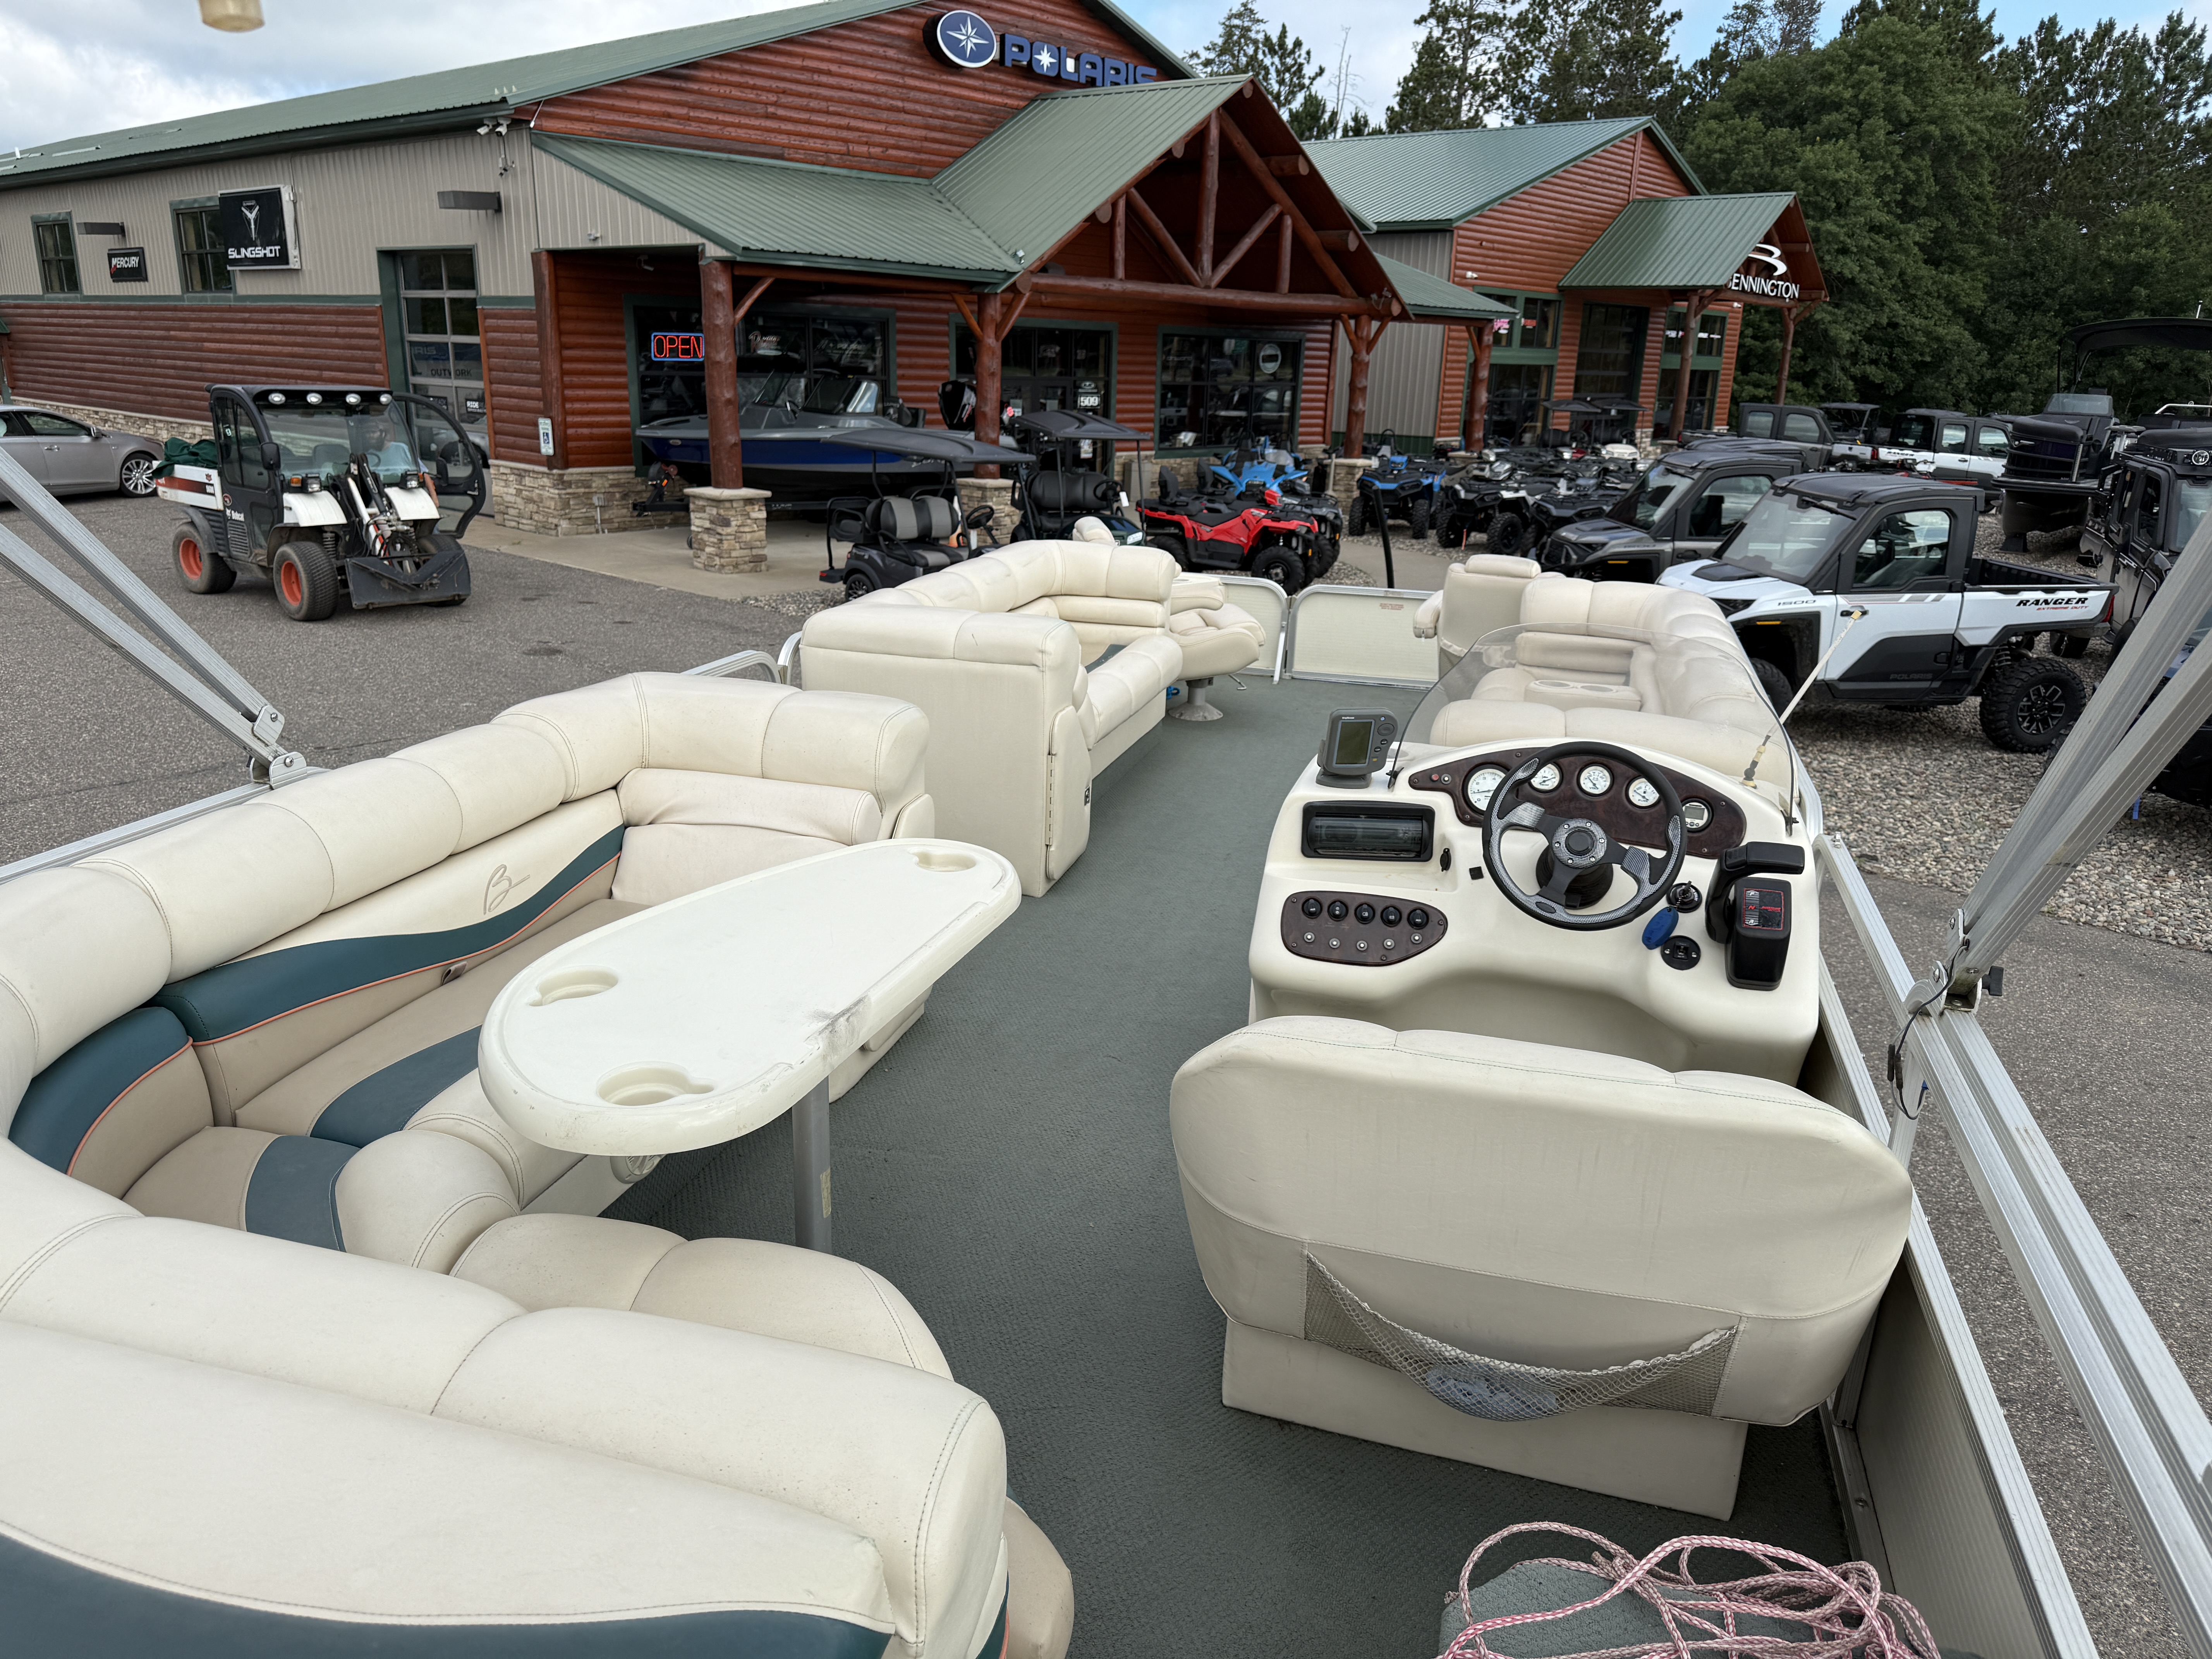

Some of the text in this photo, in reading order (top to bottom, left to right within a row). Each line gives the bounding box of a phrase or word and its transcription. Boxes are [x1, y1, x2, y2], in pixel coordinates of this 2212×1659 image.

[1001, 34, 1157, 86] POLARIS
[228, 246, 281, 259] SLINGSHOT
[112, 256, 139, 268] MERCURY
[654, 335, 702, 358] OPEN
[1080, 397, 1099, 407] 509
[2016, 597, 2088, 607] RANGER
